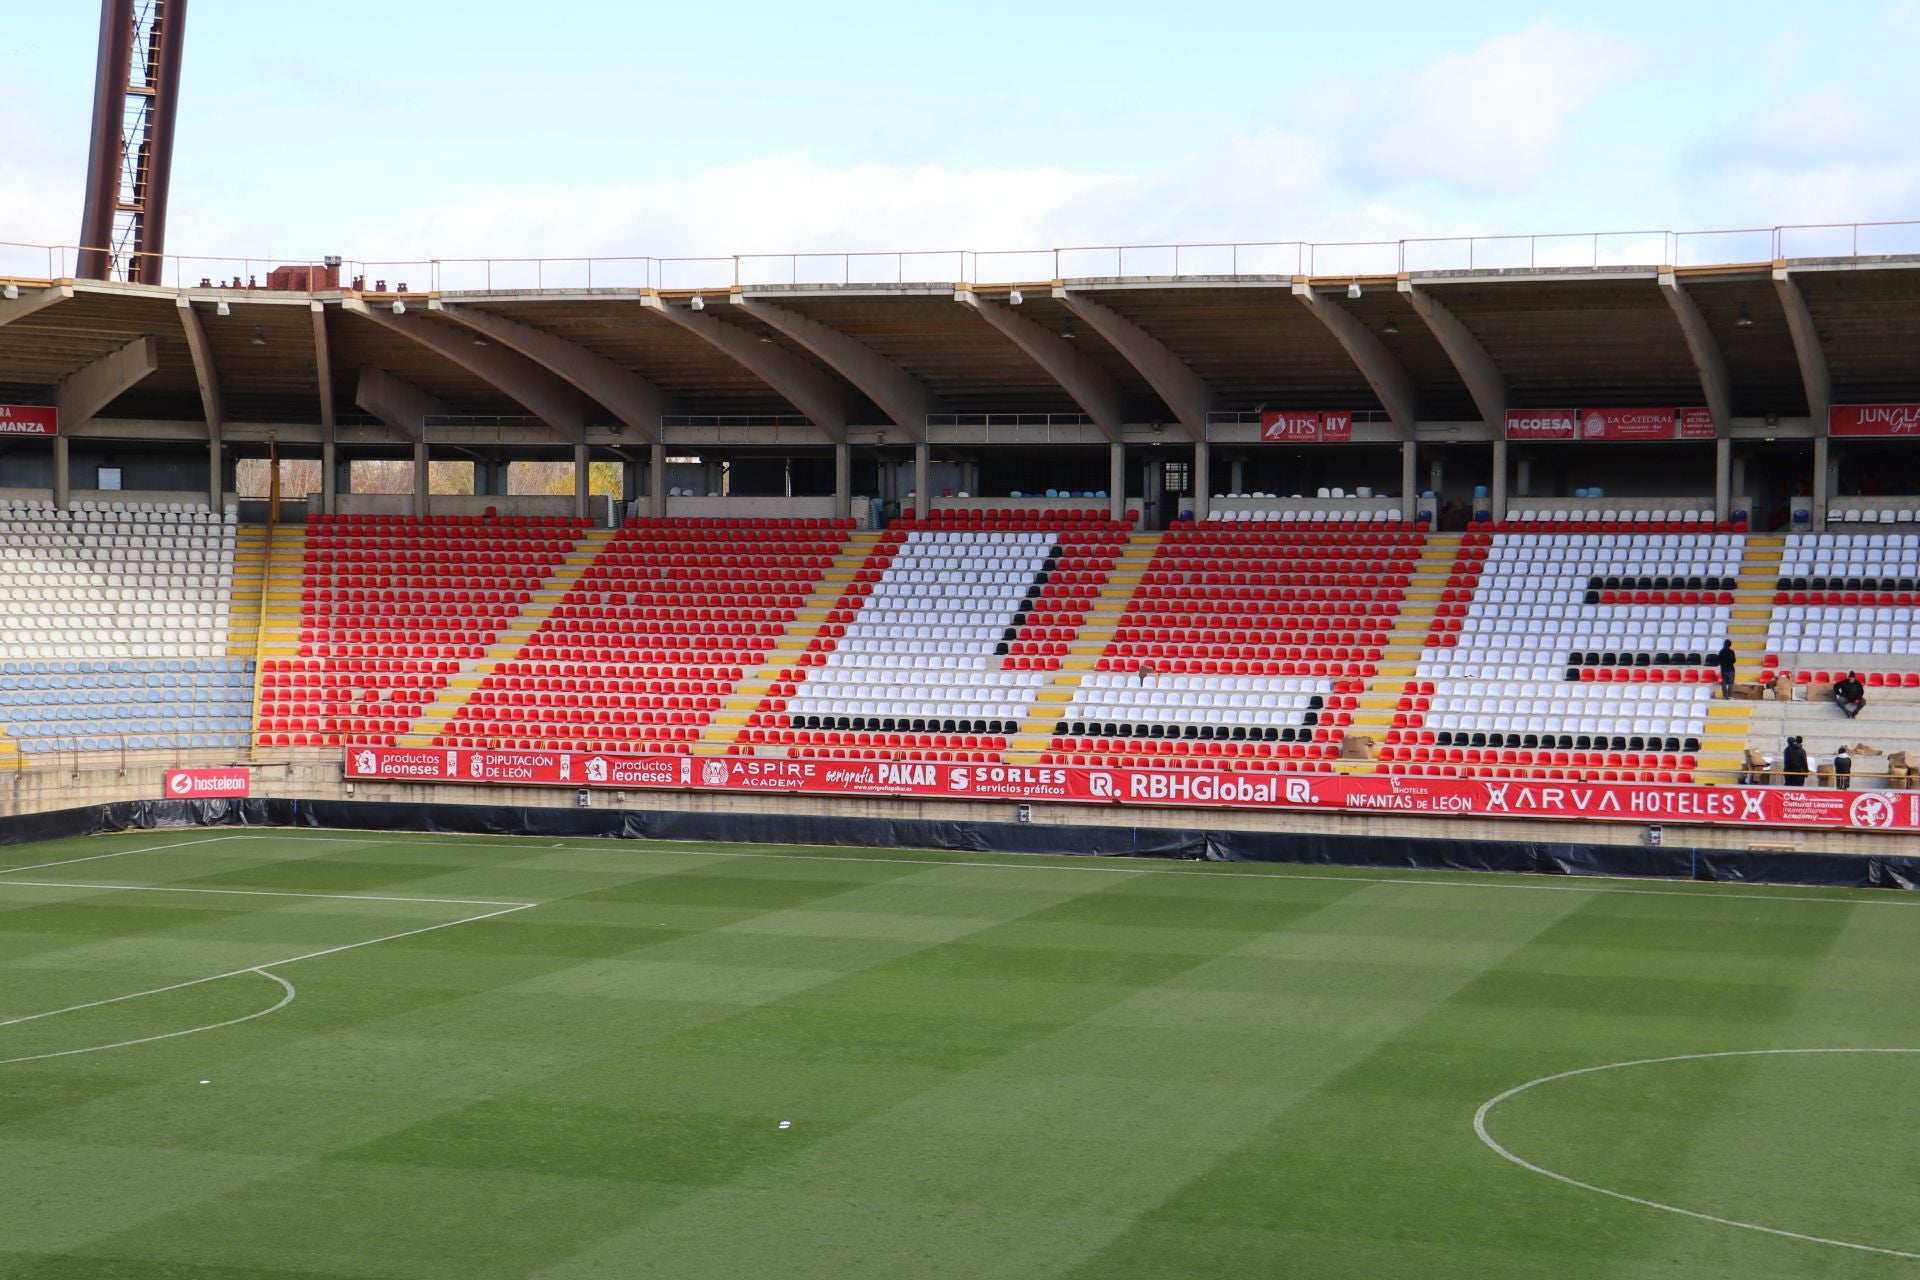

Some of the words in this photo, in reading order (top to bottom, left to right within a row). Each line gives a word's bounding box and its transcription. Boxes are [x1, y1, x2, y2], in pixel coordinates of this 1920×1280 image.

[1288, 419, 1316, 434] IPS
[1326, 417, 1347, 431] HV
[1520, 418, 1572, 430] COESA
[1607, 416, 1619, 424] LA
[382, 753, 440, 766] productos
[485, 754, 553, 767] DIPUTACIÓN
[614, 760, 673, 772] productos
[380, 761, 439, 776] leoneses
[485, 767, 500, 778] DE
[502, 766, 532, 778] LEÓN
[612, 768, 673, 783] leoneses
[878, 763, 937, 786] PAKAR
[975, 767, 1066, 784] SORLES
[194, 774, 246, 791] hosteleón
[742, 778, 805, 788] ACADEMY
[1130, 774, 1277, 802] RBHGlobal
[975, 784, 1021, 793] servicios
[1023, 784, 1065, 796] gráficos
[1346, 793, 1412, 809] INFANTAS
[1416, 800, 1428, 809] DE
[1432, 794, 1472, 811] LEÓN
[1631, 791, 1735, 815] HOTELES
